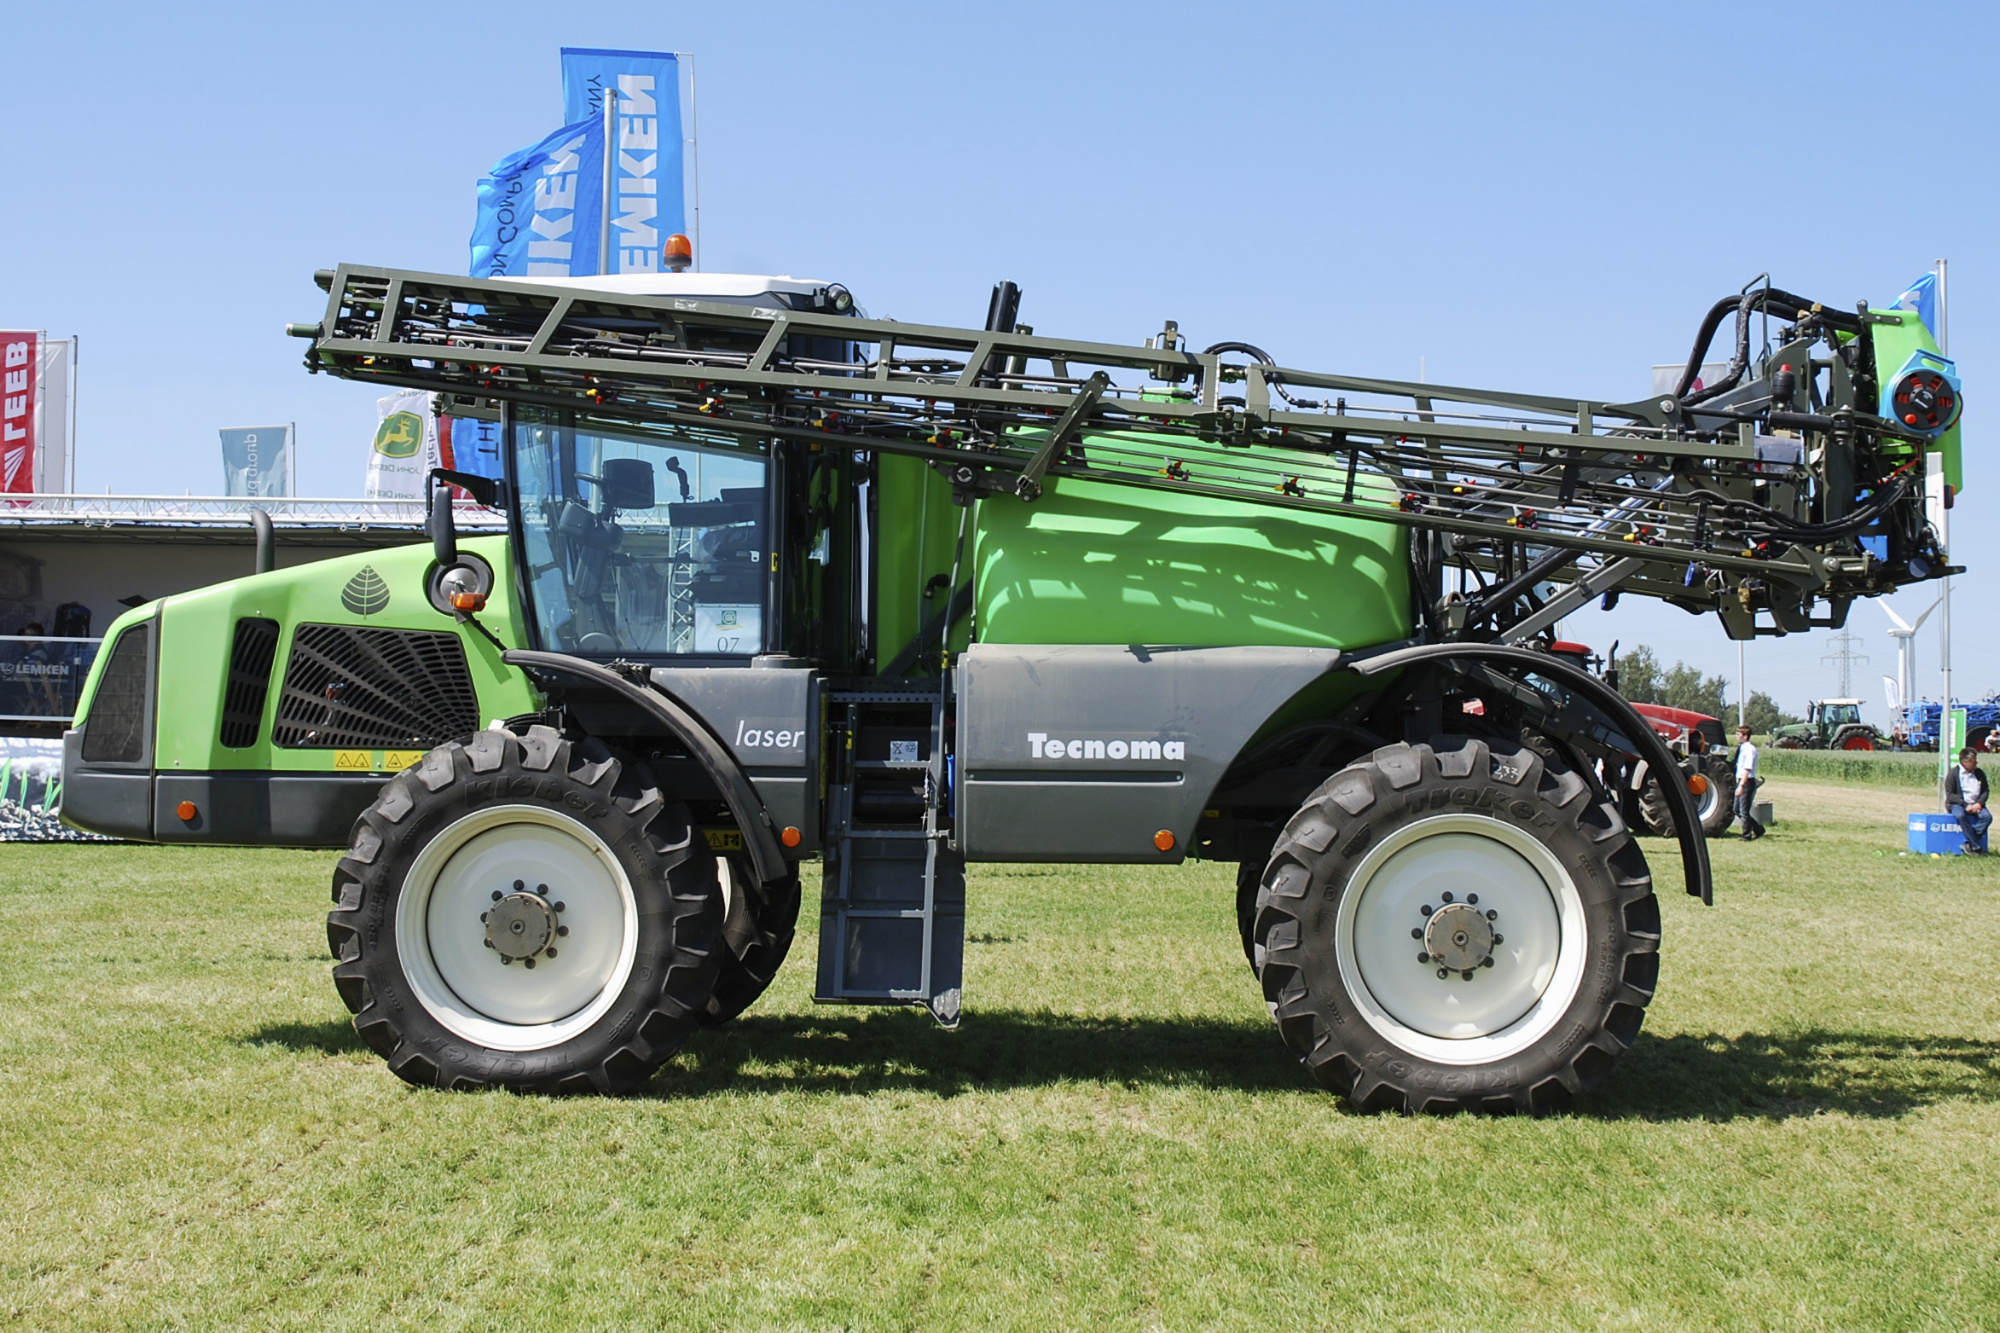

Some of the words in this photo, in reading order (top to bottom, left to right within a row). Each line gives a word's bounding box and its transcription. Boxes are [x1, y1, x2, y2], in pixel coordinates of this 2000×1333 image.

[717, 636, 740, 653] 07
[15, 664, 70, 676] LEMKEN
[735, 719, 806, 748] laser
[1027, 732, 1186, 761] Tecnoma
